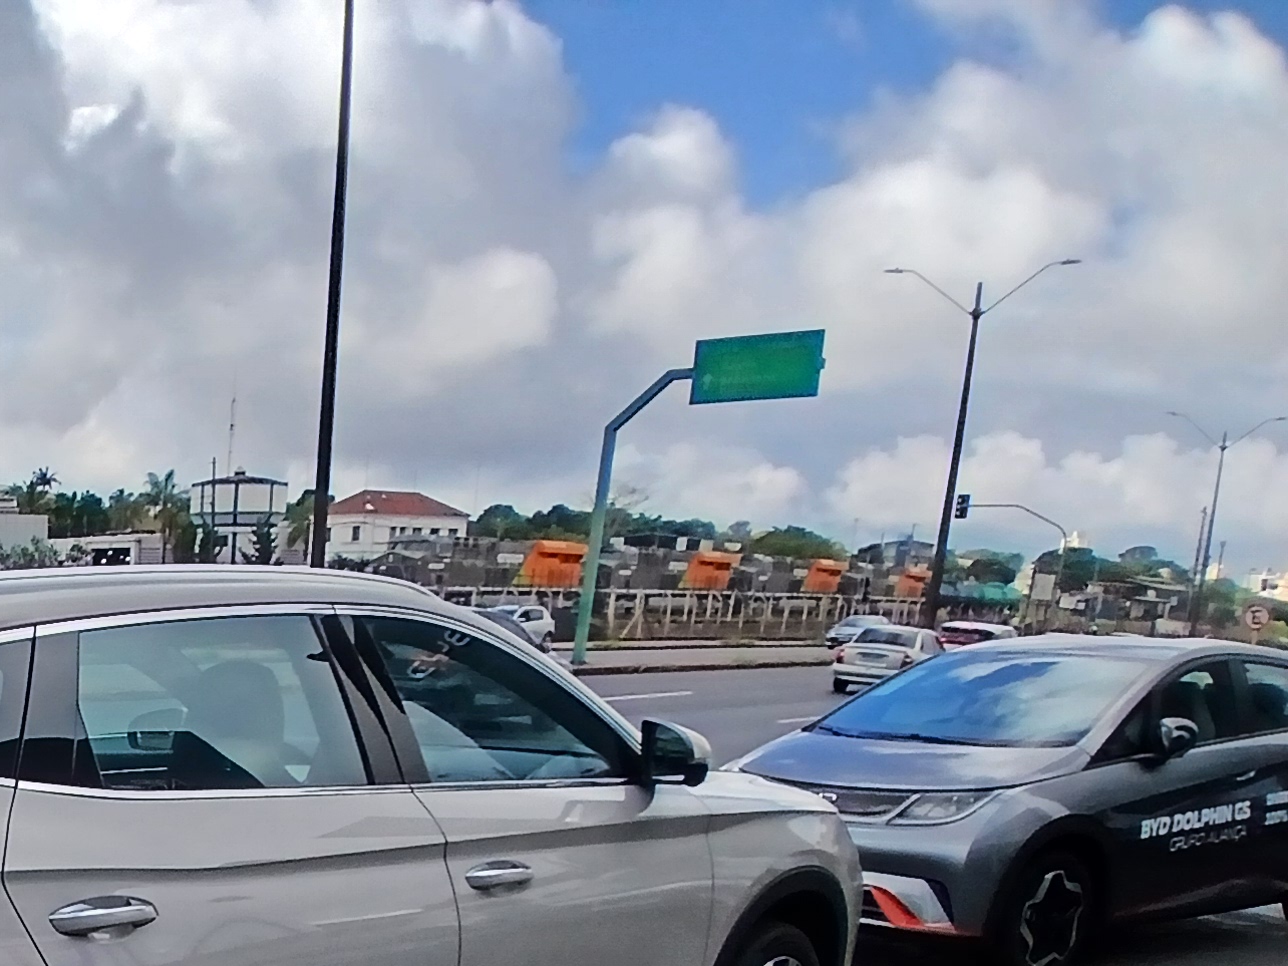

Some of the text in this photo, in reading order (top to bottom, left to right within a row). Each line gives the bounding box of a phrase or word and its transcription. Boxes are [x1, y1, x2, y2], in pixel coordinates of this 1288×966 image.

[1140, 801, 1251, 839] BYD DOLPHIN GS
